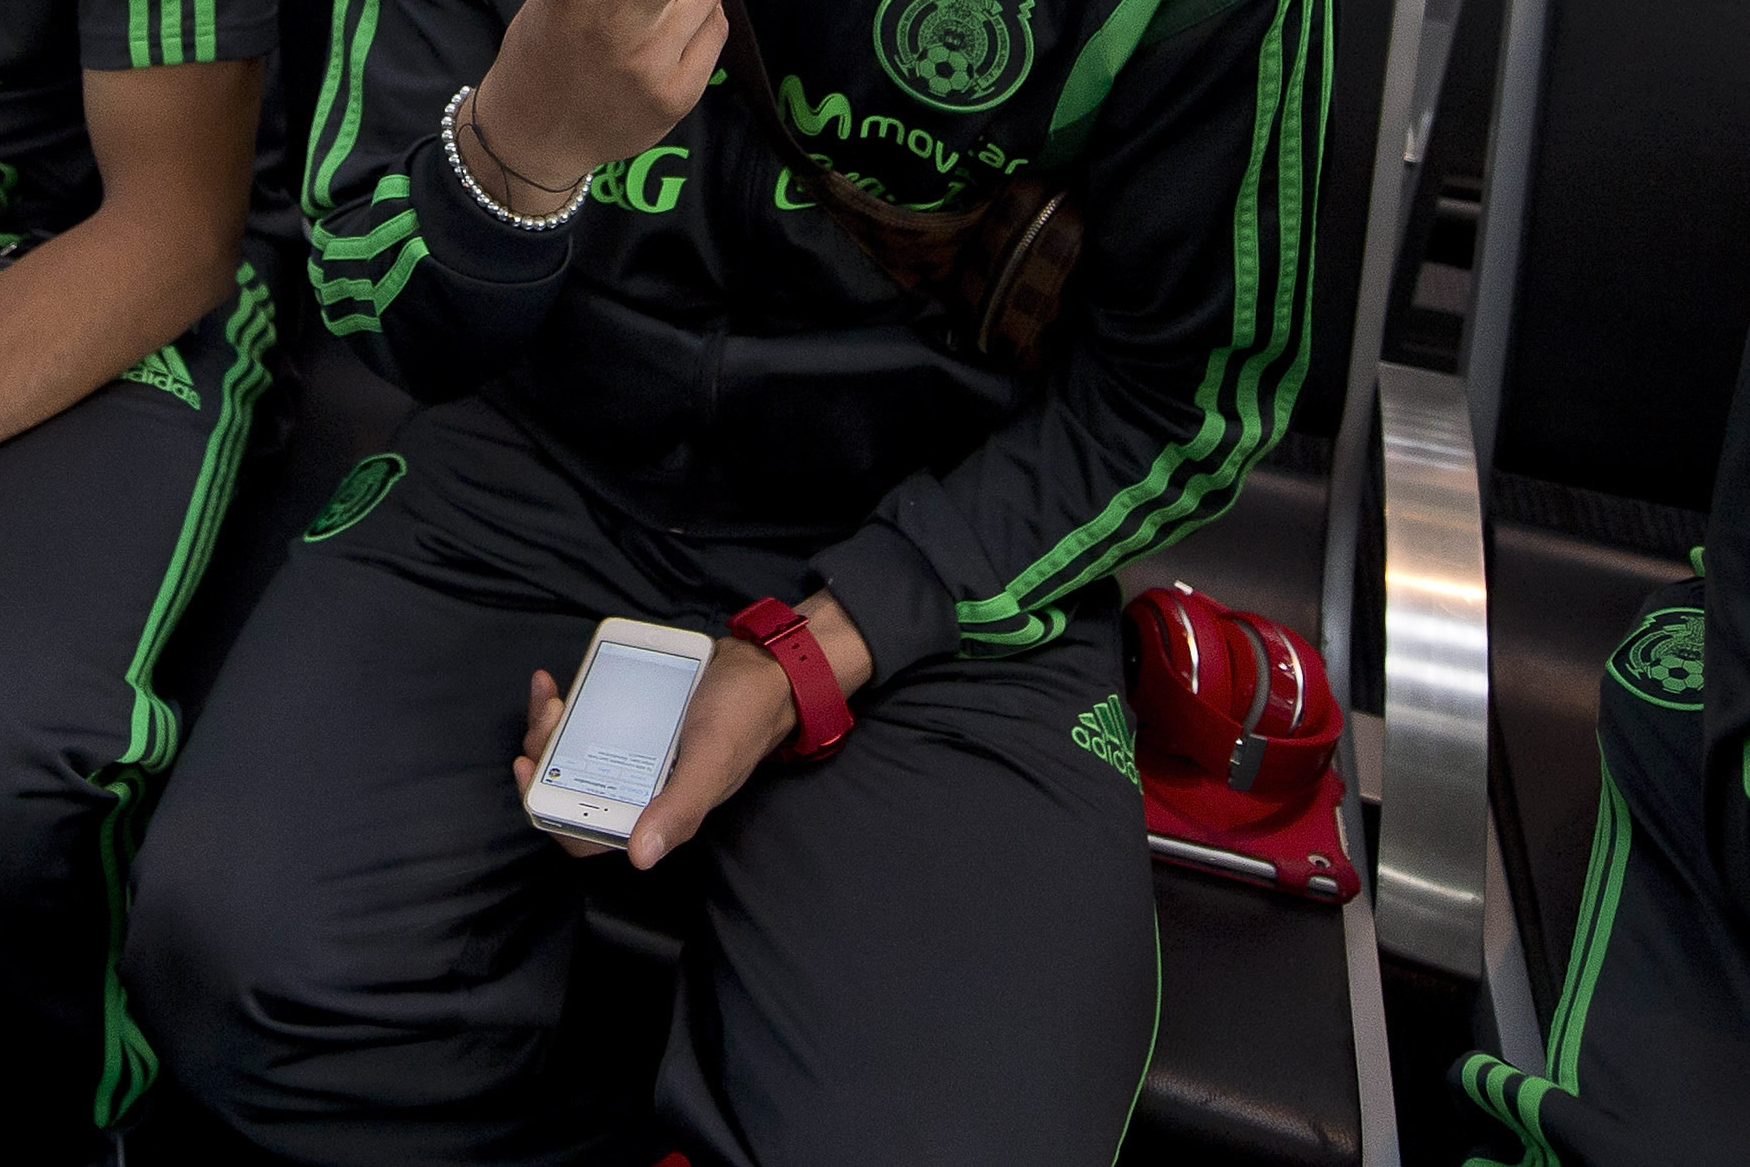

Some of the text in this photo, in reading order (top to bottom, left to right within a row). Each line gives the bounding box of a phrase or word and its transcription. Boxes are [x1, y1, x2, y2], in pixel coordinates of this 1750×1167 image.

[589, 146, 690, 214] &G
[121, 363, 202, 410] didas
[1070, 726, 1144, 796] adida
